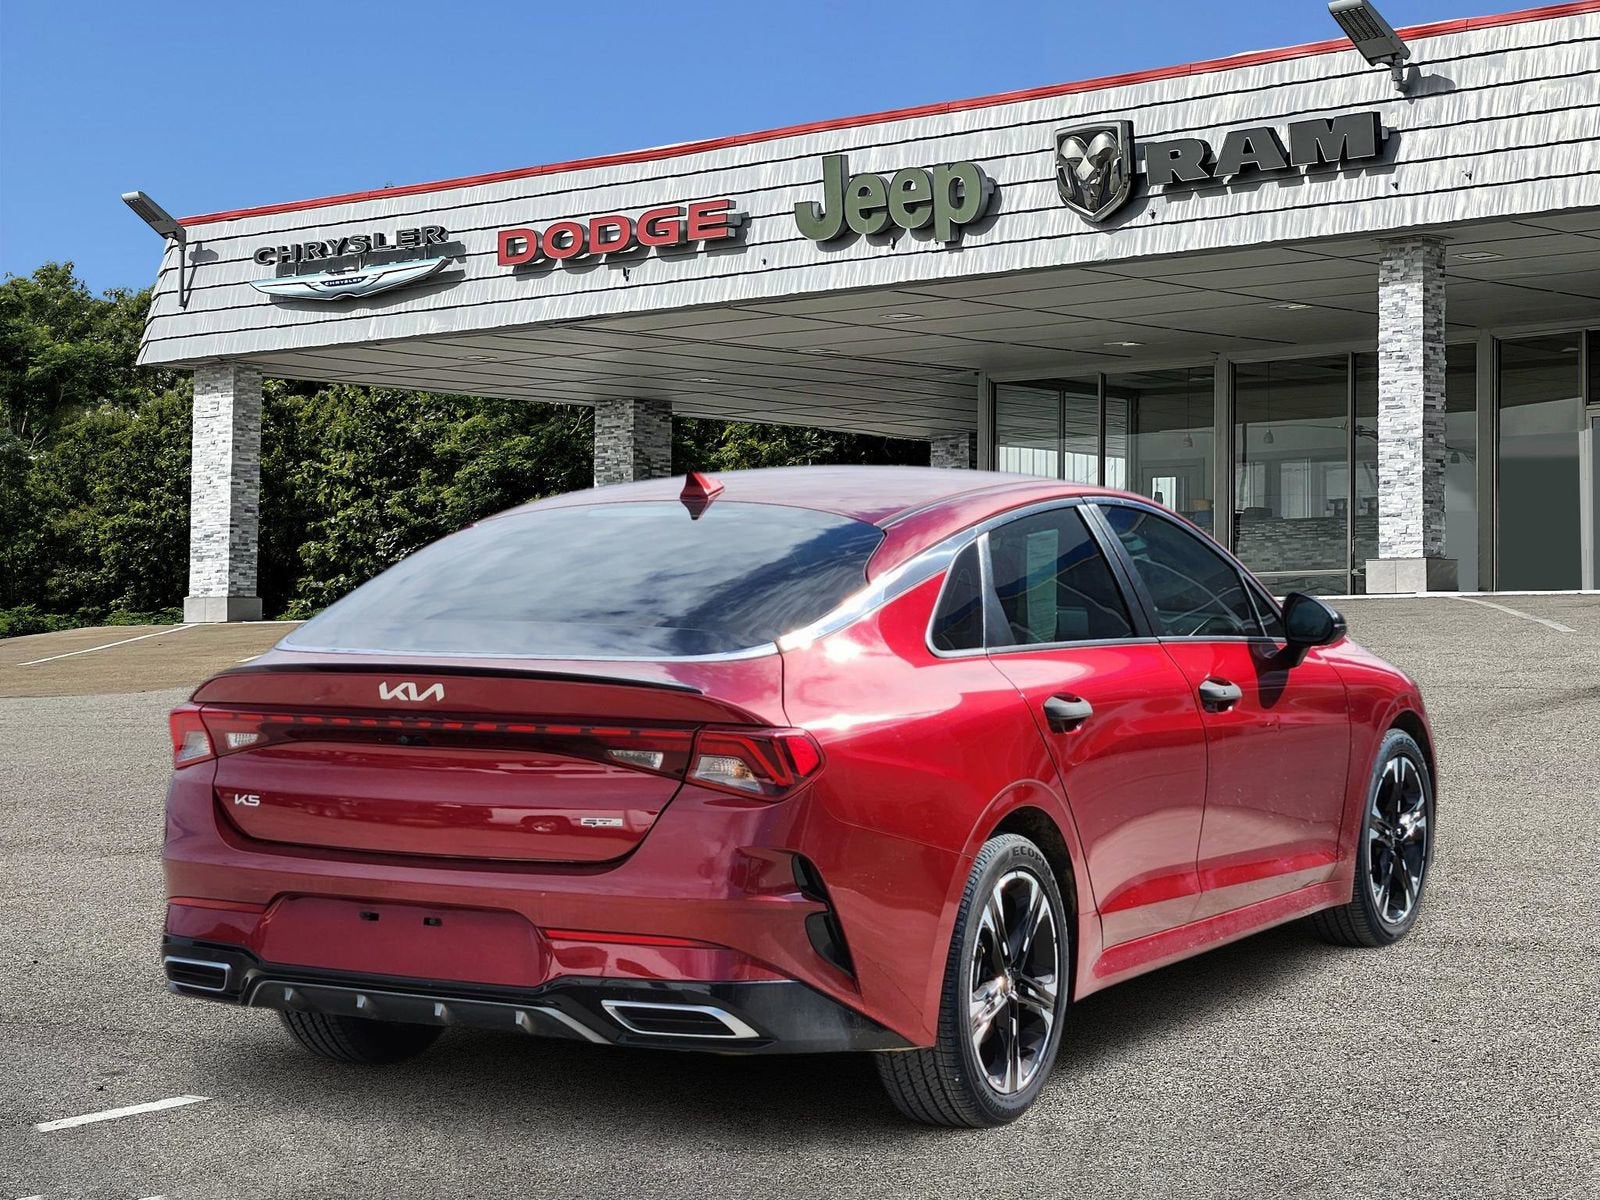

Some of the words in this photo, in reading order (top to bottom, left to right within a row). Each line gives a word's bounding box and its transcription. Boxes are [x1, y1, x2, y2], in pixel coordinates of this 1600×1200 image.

[1145, 111, 1381, 186] RAM
[794, 154, 987, 243] Jeep
[253, 225, 449, 266] CHRYSLER
[497, 199, 736, 267] DODGE
[324, 277, 363, 286] CHRYSLER
[378, 681, 445, 702] KIA
[234, 793, 261, 807] K5
